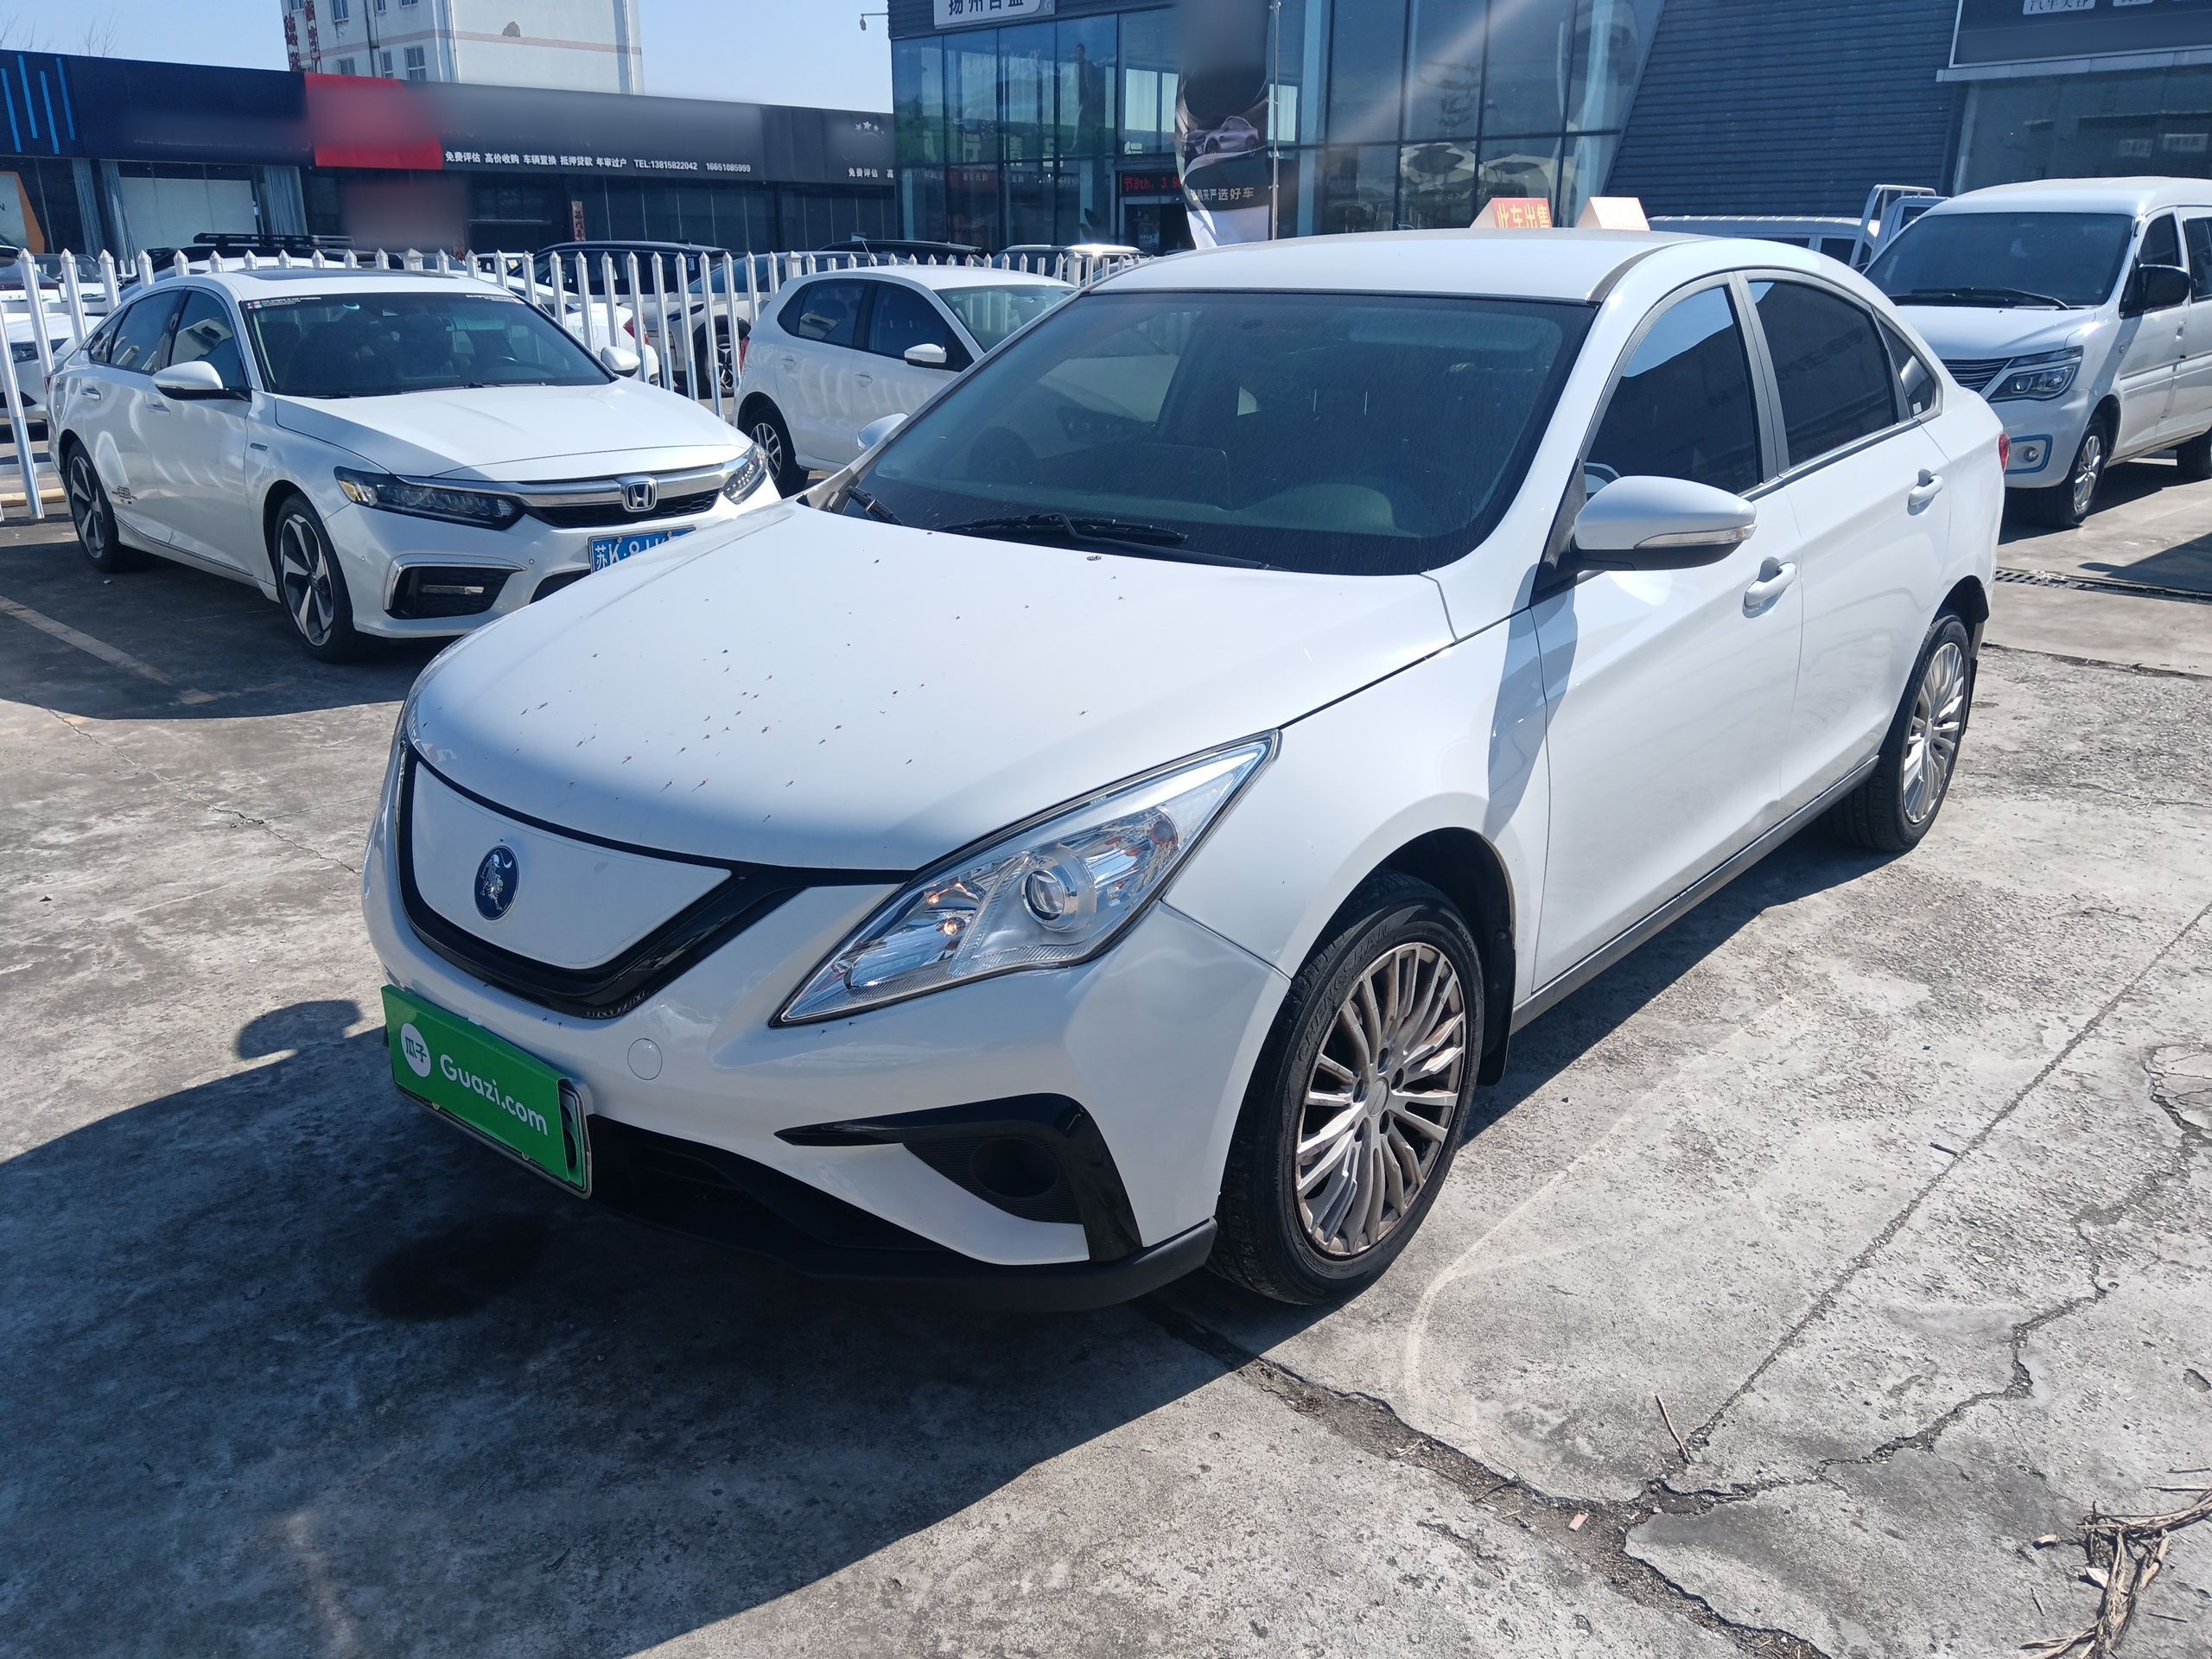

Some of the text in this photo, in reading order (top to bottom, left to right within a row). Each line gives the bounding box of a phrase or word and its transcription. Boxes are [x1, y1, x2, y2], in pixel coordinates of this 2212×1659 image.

[445, 150, 480, 162] 免费评估
[485, 153, 519, 164] 高价收购
[523, 154, 556, 166] 车辆置换
[560, 155, 593, 166] 抵押贷款
[596, 156, 626, 168] 年审过户
[706, 162, 751, 173] 16651085999
[849, 168, 878, 179] 免费评估
[404, 1036, 428, 1064] 瓜子
[440, 1053, 548, 1136] Guazi.com
